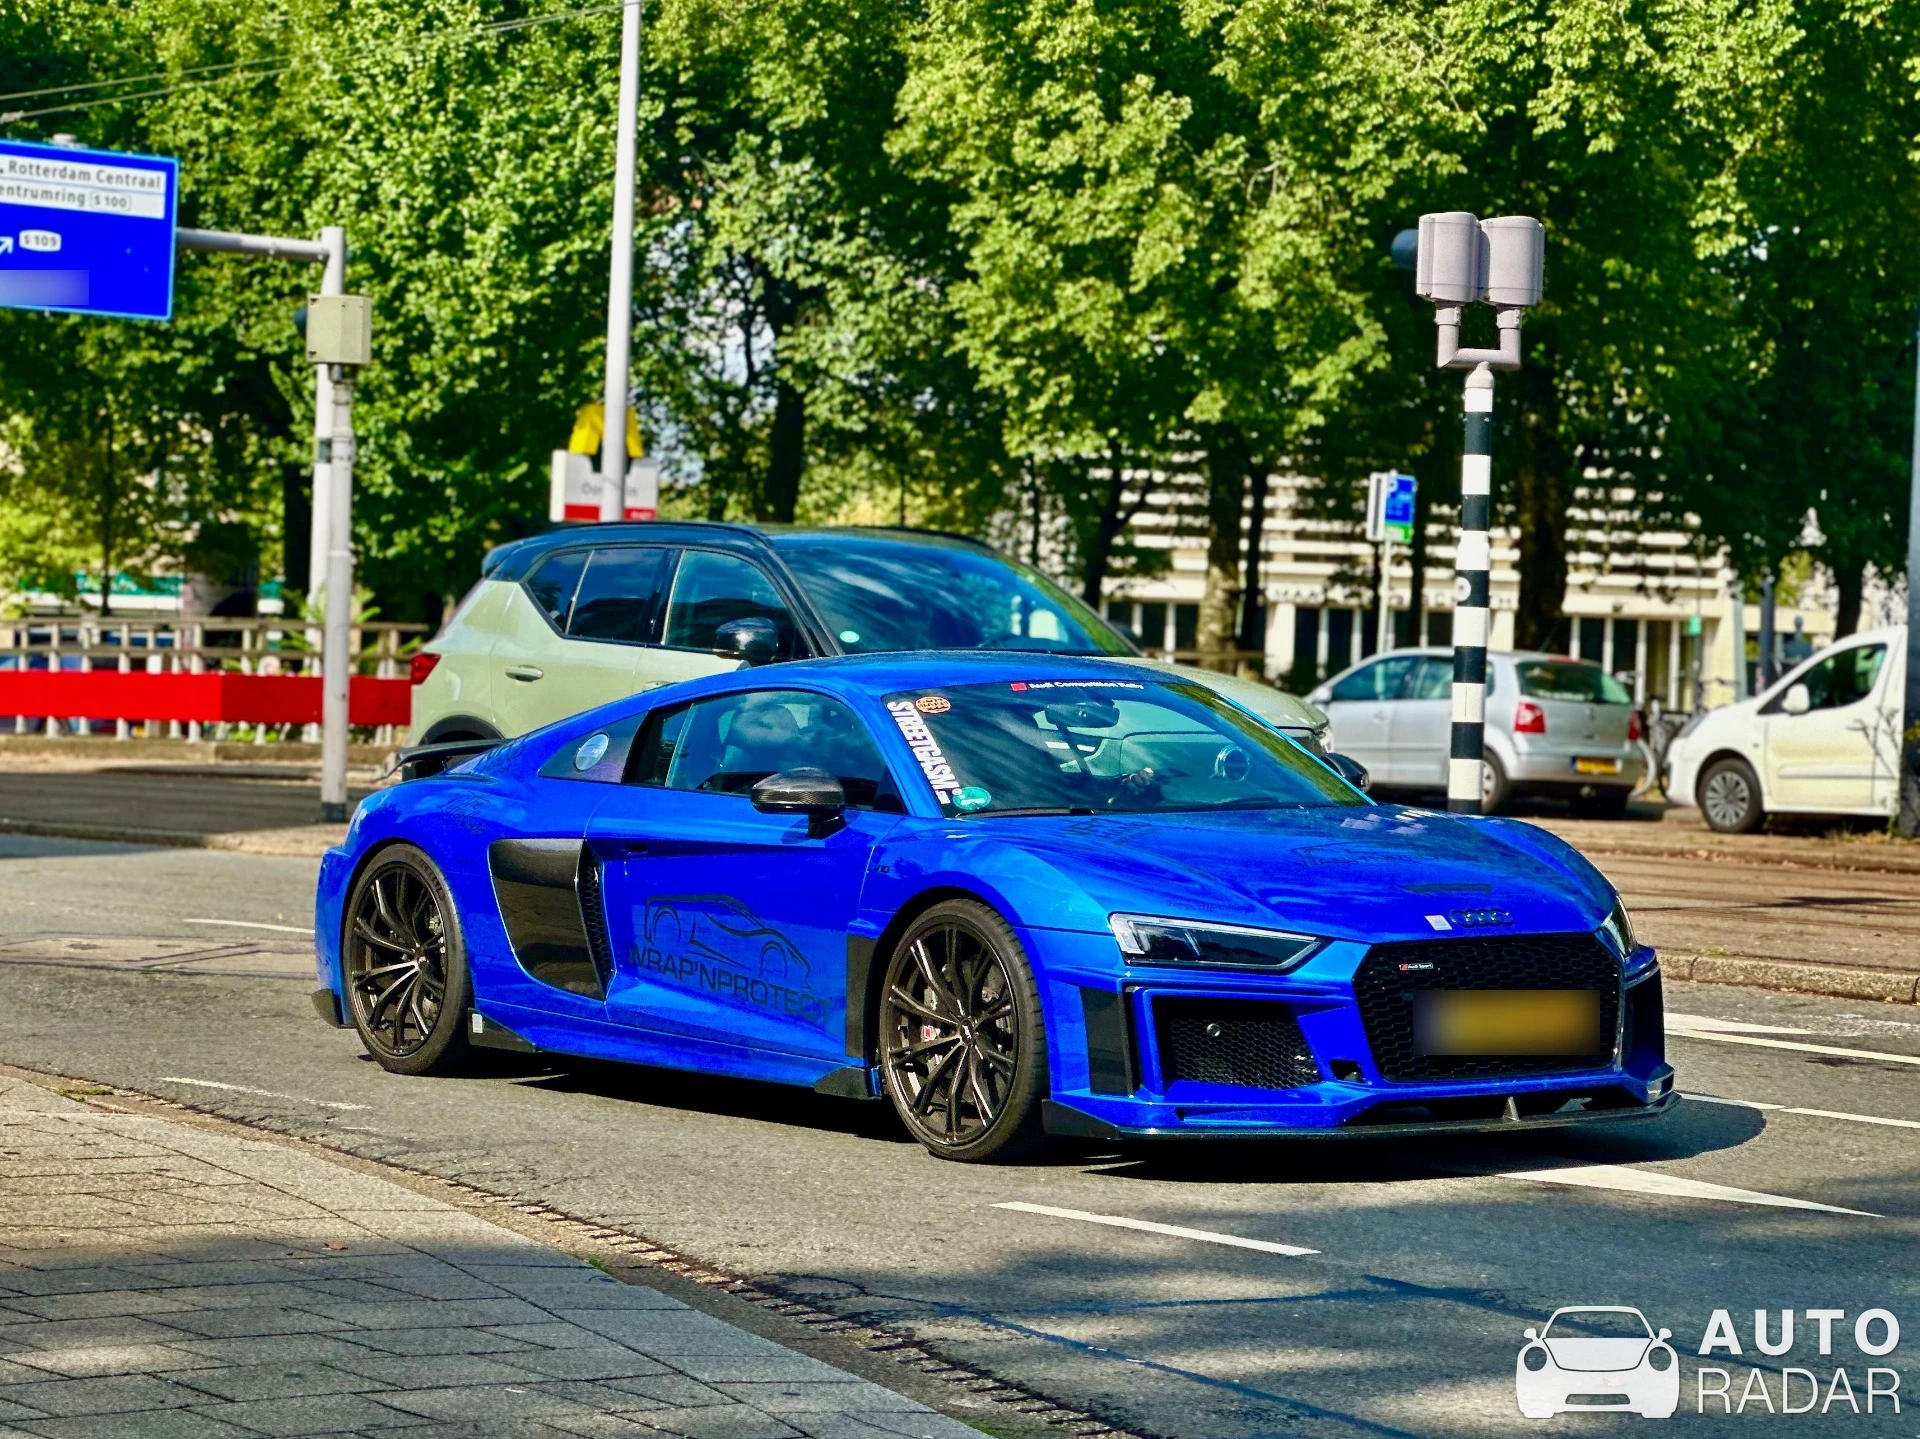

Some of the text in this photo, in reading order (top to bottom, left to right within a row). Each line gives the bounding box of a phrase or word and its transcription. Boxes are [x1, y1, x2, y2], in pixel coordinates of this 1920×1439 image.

[9, 160, 161, 189] Rotterdam Centraal
[105, 196, 128, 208] 100
[35, 235, 57, 248] 109
[886, 701, 961, 791] STREETGASM
